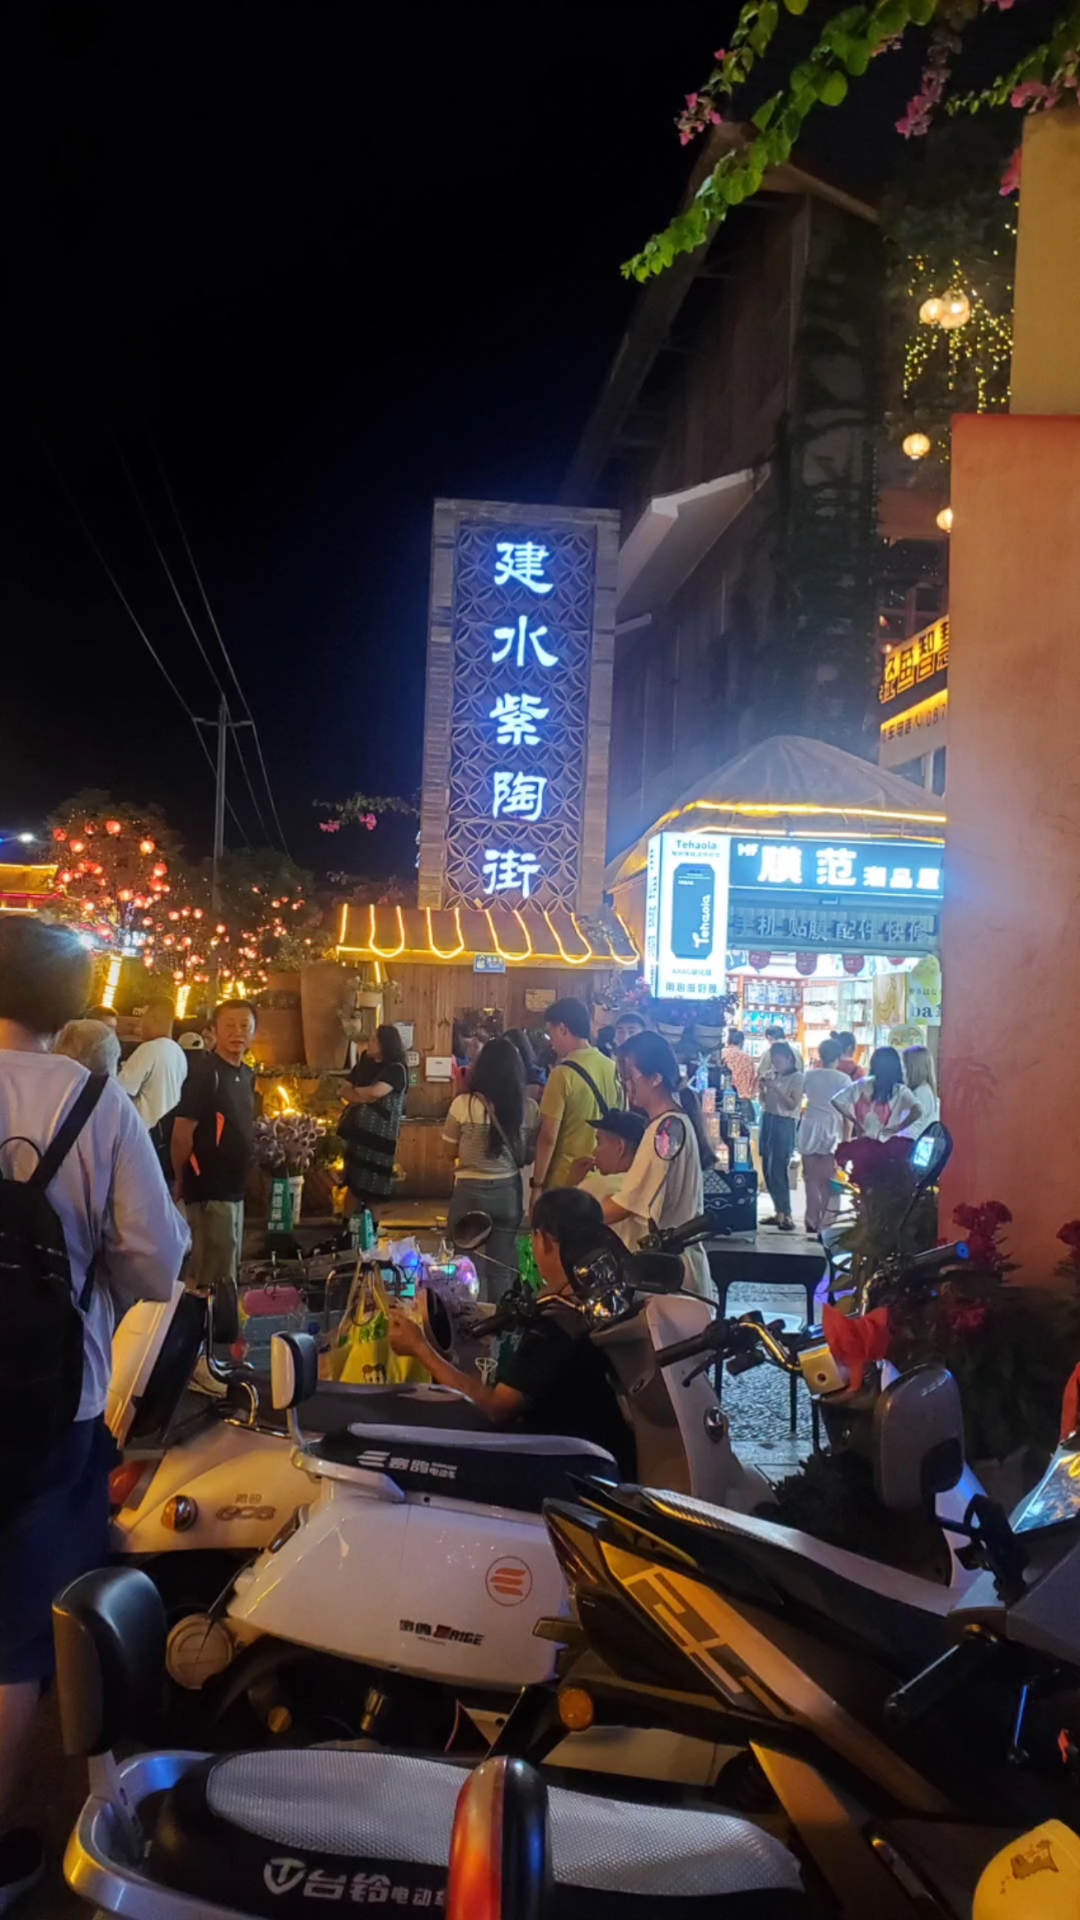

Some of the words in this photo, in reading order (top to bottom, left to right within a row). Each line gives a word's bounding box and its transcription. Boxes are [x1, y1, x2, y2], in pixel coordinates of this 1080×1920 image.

[482, 541, 559, 899] 建水紫陶街
[303, 1869, 391, 1904] 台铃
